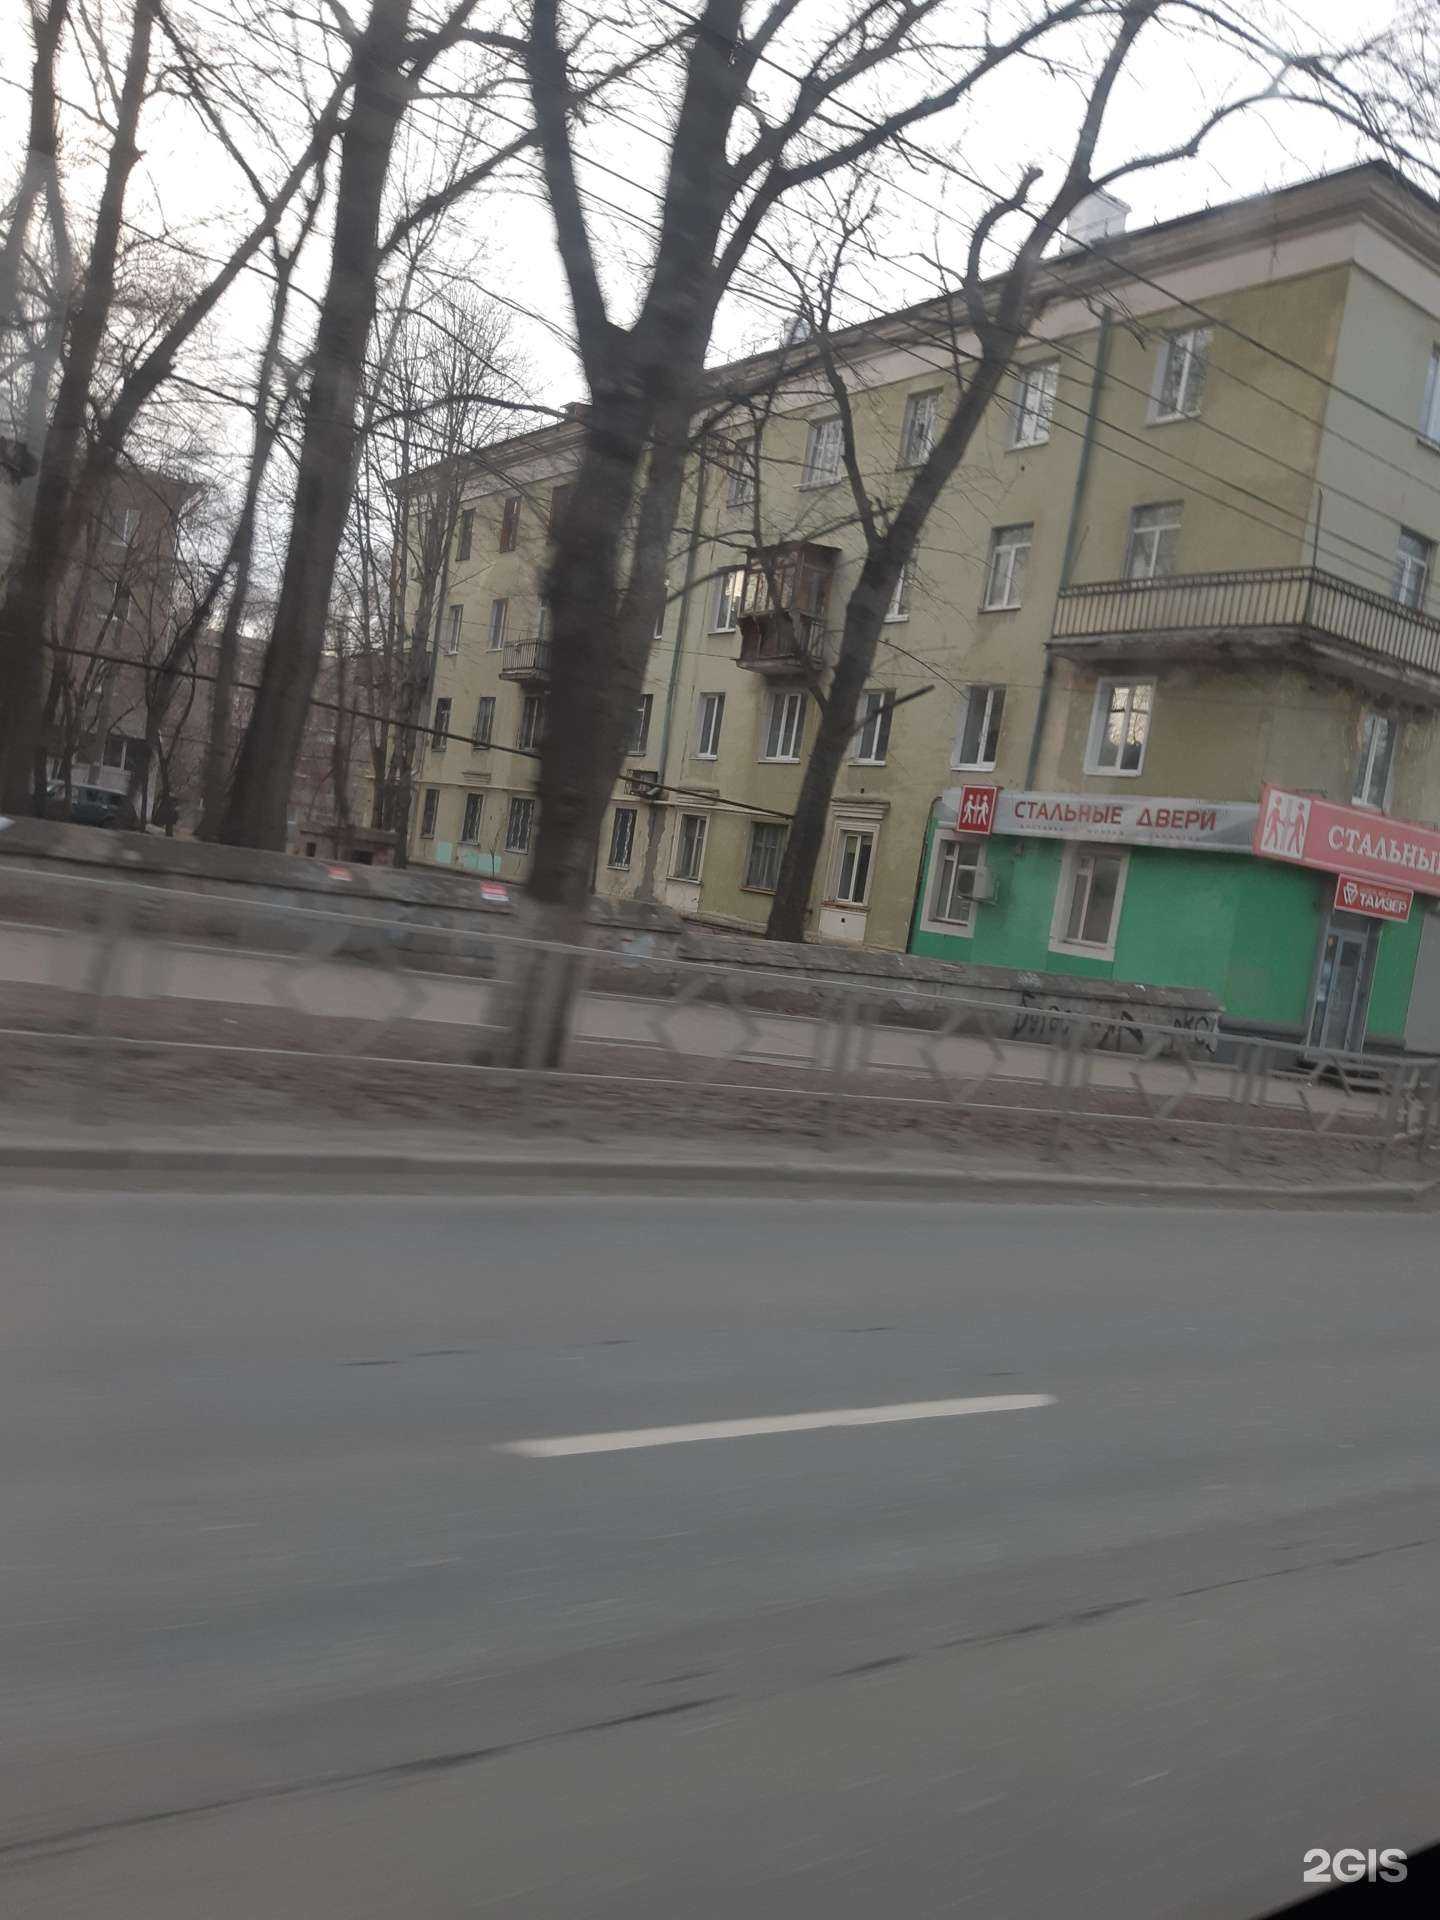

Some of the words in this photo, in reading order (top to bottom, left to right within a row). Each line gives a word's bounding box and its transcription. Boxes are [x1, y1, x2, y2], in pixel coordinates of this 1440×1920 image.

[1014, 801, 1123, 825] СТАЛЬНЫЕ
[1136, 808, 1217, 831] ДВЕРИ
[1328, 825, 1440, 875] СТАЛЬНЫ
